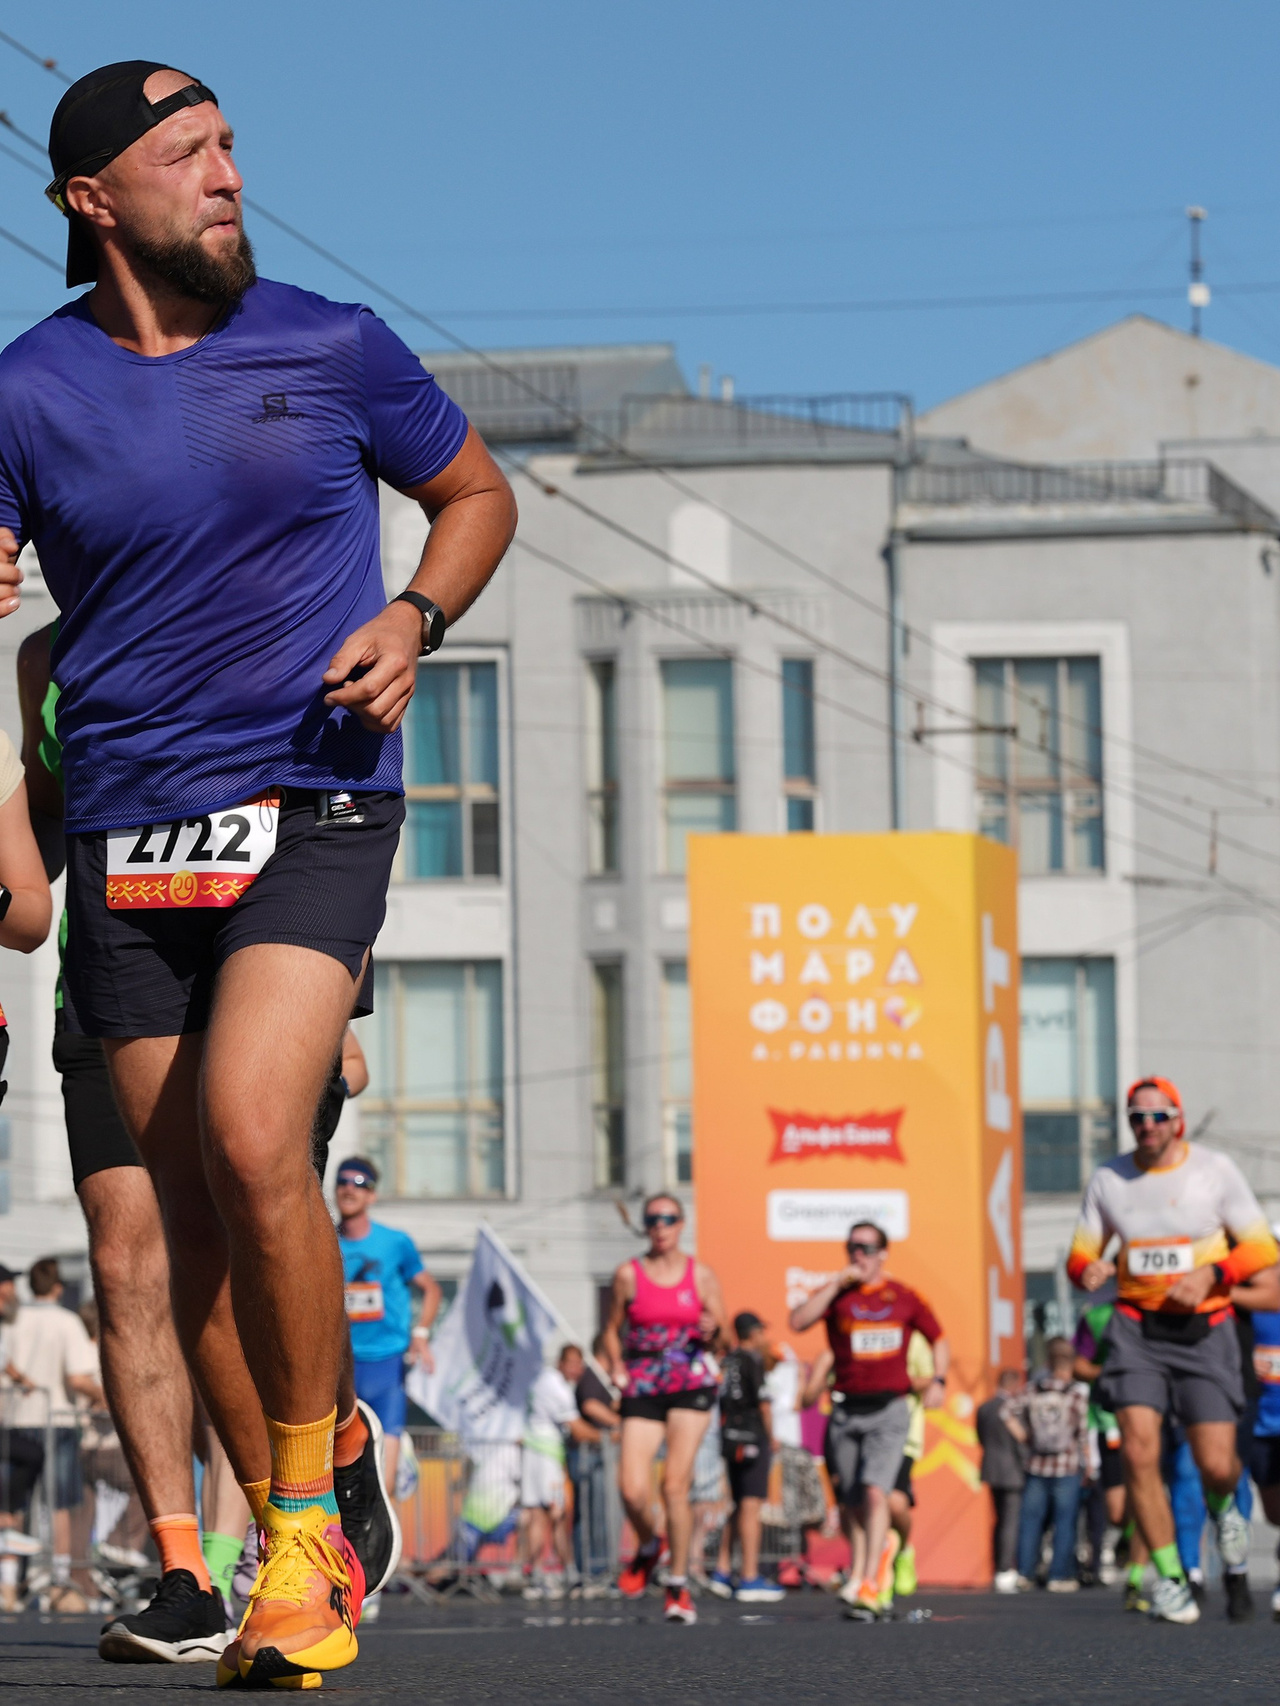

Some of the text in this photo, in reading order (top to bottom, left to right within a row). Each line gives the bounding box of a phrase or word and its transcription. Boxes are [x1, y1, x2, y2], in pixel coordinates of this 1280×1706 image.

[126, 814, 251, 863] 2722
[751, 903, 918, 939] ПОЛУ
[751, 948, 923, 985] МАРА
[749, 998, 877, 1034] ФОН
[982, 912, 1016, 1367] ТАРТ
